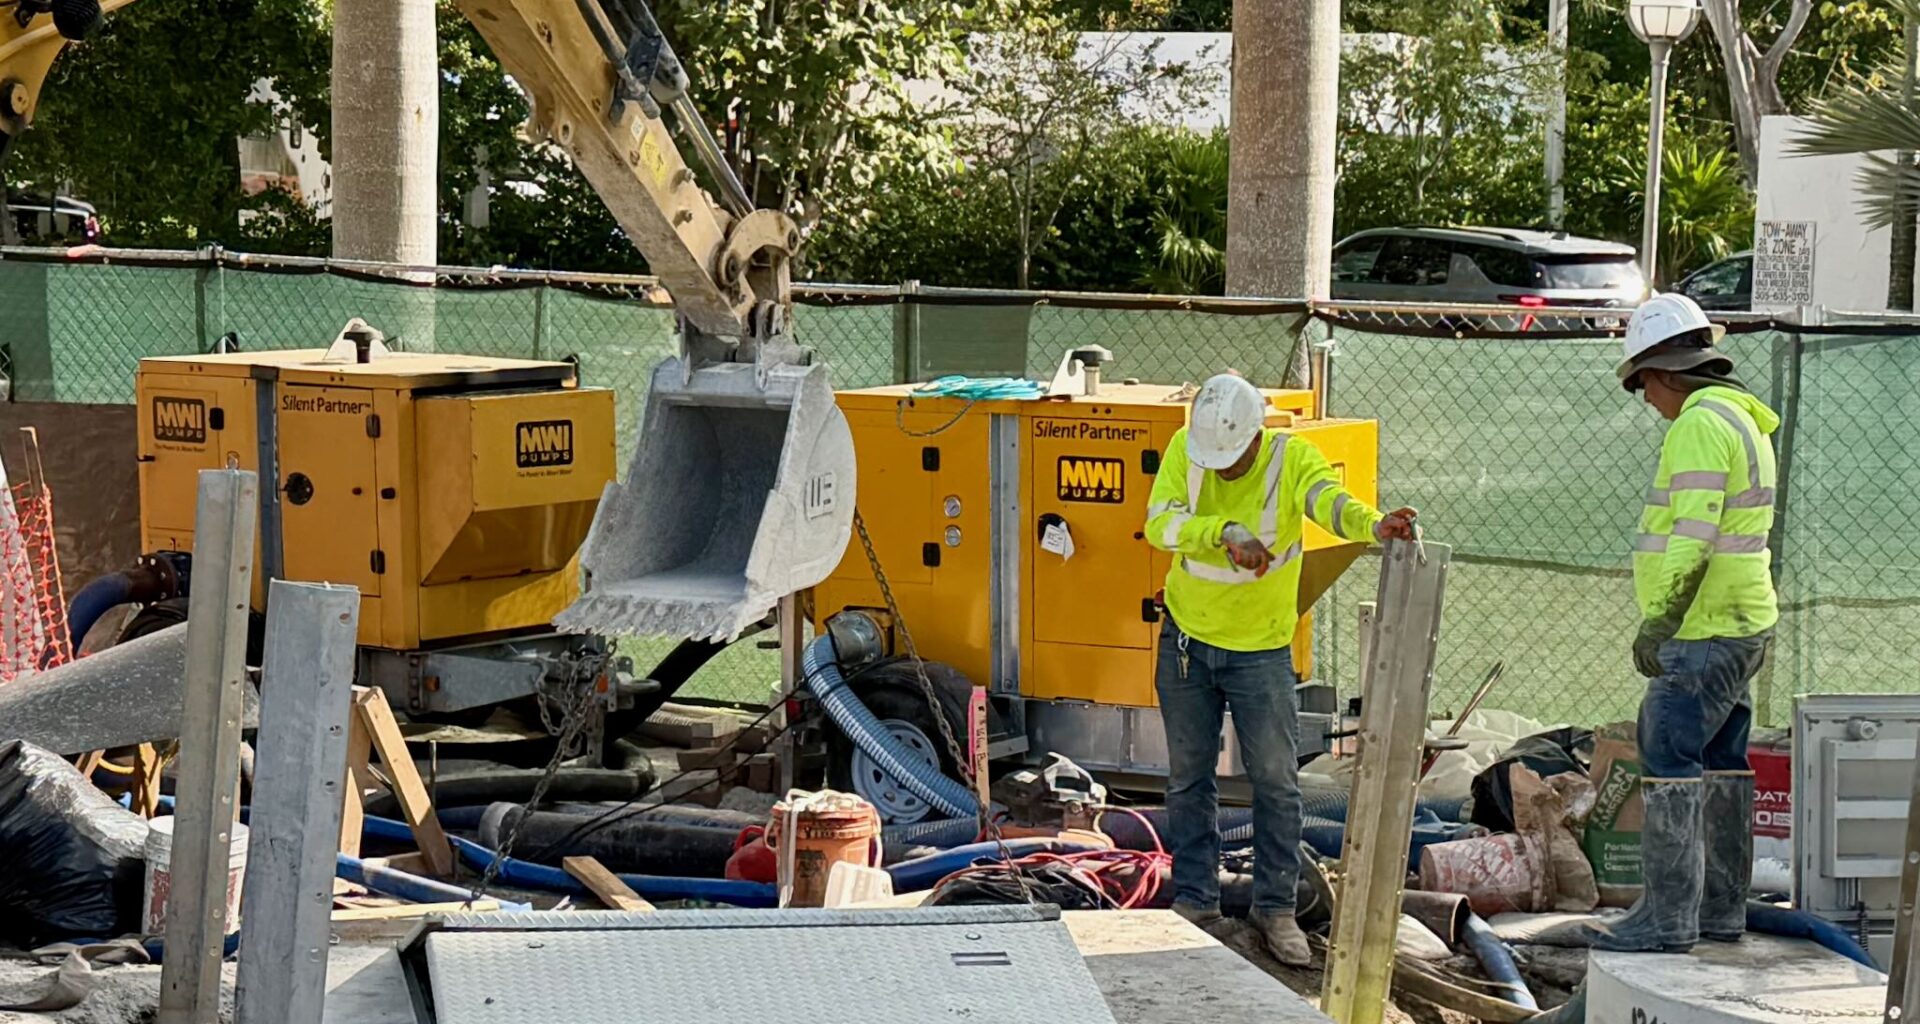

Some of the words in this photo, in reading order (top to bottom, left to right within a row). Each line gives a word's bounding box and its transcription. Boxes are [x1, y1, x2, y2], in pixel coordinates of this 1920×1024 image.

[1762, 223, 1808, 238] TOW-AWAY
[1773, 239, 1796, 254] ZONE
[282, 394, 315, 412] Silent
[156, 401, 203, 429] MWI
[157, 427, 203, 439] PUMPS
[1035, 420, 1077, 439] Silent
[520, 425, 570, 453] MWI
[520, 451, 570, 463] PUMPS
[1061, 460, 1121, 489] MWI
[1060, 487, 1121, 500] PUMPS
[1601, 772, 1637, 831] AMERICA
